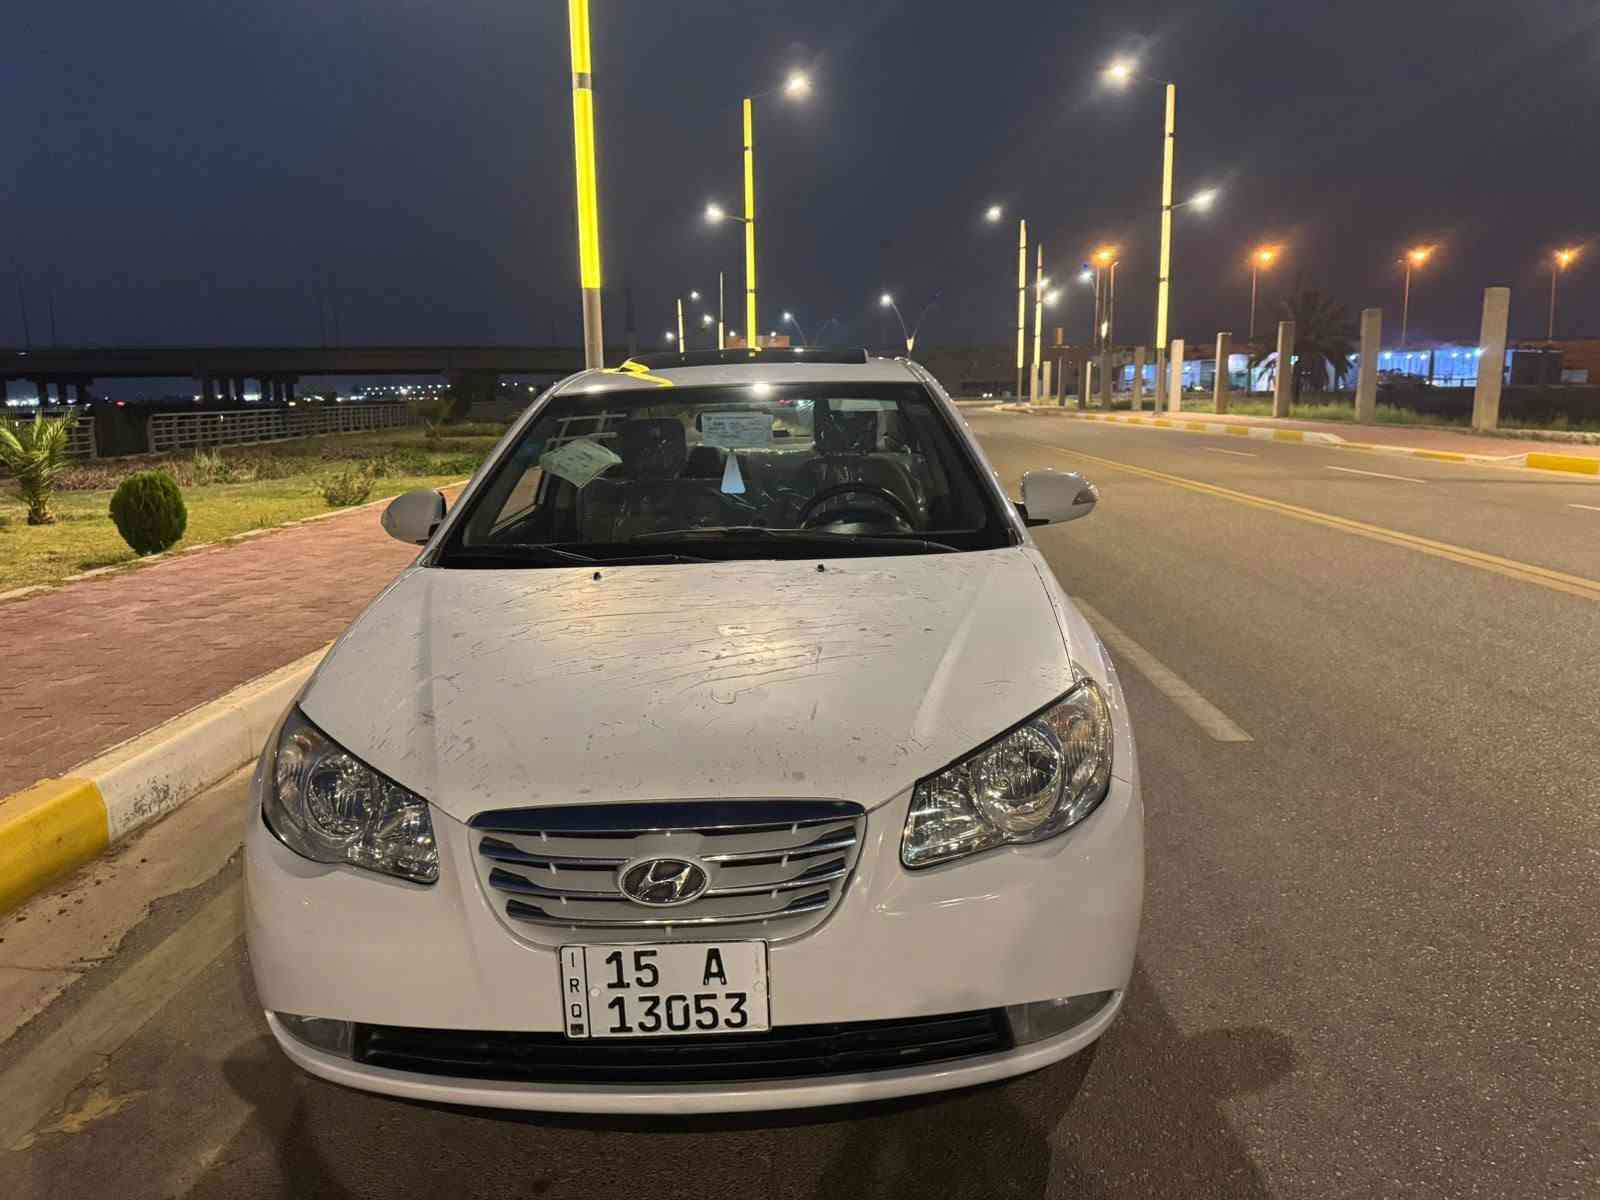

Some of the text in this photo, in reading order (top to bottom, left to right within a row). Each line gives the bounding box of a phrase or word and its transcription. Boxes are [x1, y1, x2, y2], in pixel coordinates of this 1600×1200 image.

[605, 948, 727, 988] 15 A
[608, 992, 748, 1033] 13053
